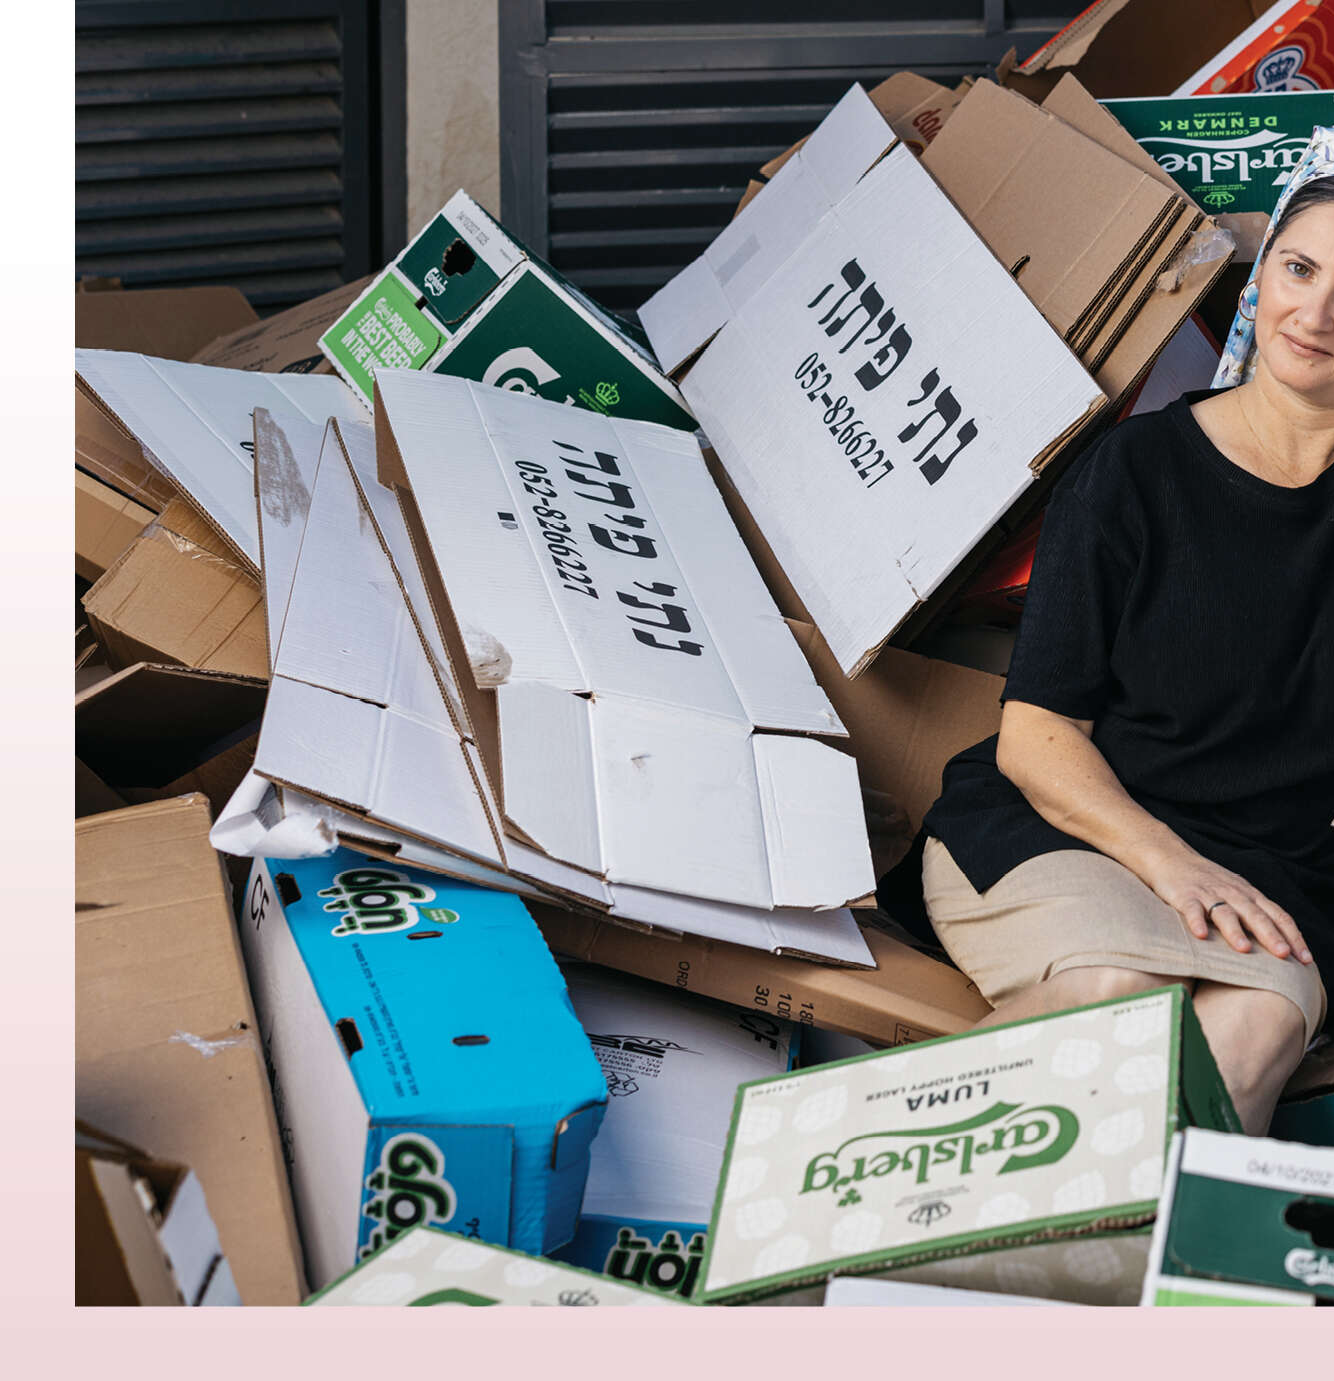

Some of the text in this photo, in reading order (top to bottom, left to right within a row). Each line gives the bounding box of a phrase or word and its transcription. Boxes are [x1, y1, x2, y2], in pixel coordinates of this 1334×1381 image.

[1159, 116, 1278, 132] DENMARK
[1186, 129, 1250, 138] COPENHAGEN
[360, 315, 393, 351] BEST
[385, 312, 427, 358] PROBABLY
[806, 257, 979, 487] נתי פיתה
[794, 352, 895, 489] 052-8266227
[514, 460, 600, 600] 052-8266227
[551, 439, 705, 656] נתי פיתה
[250, 873, 271, 930] CF
[753, 984, 770, 1007] 30
[776, 992, 793, 1019] 100
[738, 1011, 781, 1051] CF
[866, 1058, 1034, 1102] UNFILTERED HOPPY LAGER
[906, 1080, 990, 1112] LUMA
[798, 1100, 1080, 1196] Carlsberg
